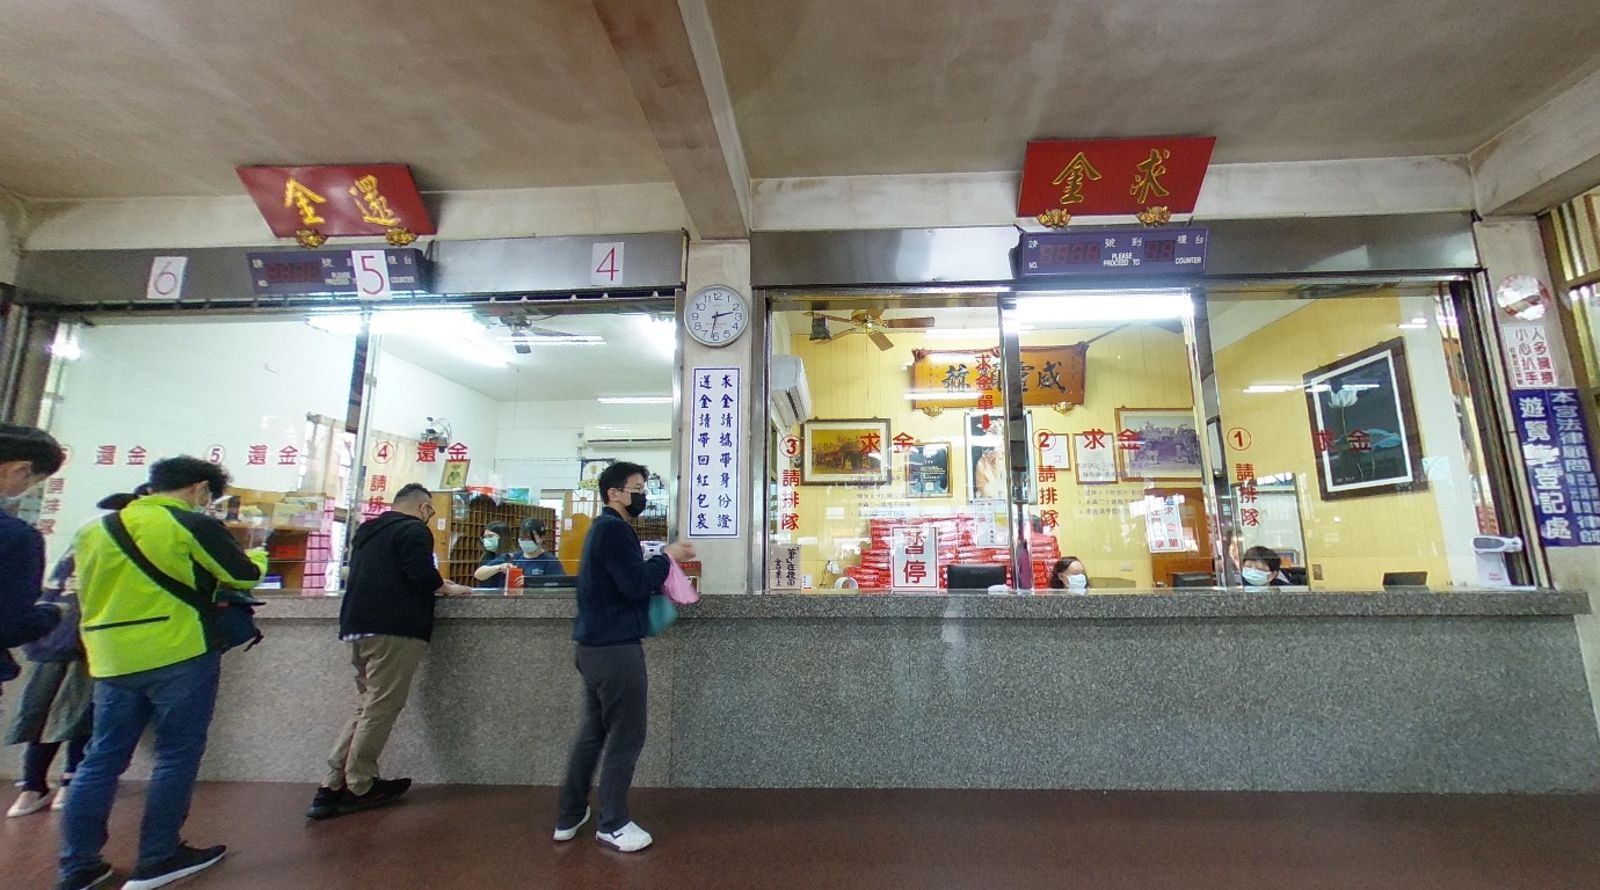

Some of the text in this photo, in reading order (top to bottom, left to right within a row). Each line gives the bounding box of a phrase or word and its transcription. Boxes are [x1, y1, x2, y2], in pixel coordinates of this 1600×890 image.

[596, 246, 620, 282] 4
[1103, 256, 1202, 268] PROCEED TO COUNTER
[1111, 252, 1133, 260] PLEASE
[153, 260, 178, 296] 6
[360, 255, 385, 296] 5
[713, 291, 723, 301] 12
[732, 303, 740, 311] 2
[691, 312, 699, 321] 9
[695, 303, 707, 312] 10
[735, 312, 743, 322] 3
[694, 321, 702, 331] 8
[701, 329, 709, 338] 7
[712, 332, 720, 342] 6
[723, 330, 731, 339] 5
[732, 322, 739, 331] 4
[1514, 327, 1539, 385] 小心扒手
[974, 353, 994, 411] 求金單
[860, 431, 914, 454] 求金
[1083, 428, 1141, 450] 求金
[1550, 391, 1592, 473] 本宮法律顧問
[246, 444, 298, 465] 還金
[416, 441, 468, 463] 還金
[1518, 396, 1573, 540] 遊覽登記處
[782, 469, 800, 531] 請排隊
[1038, 466, 1060, 529] 請排隊
[1236, 463, 1261, 527] 請排隊
[903, 530, 928, 584] 暫停
